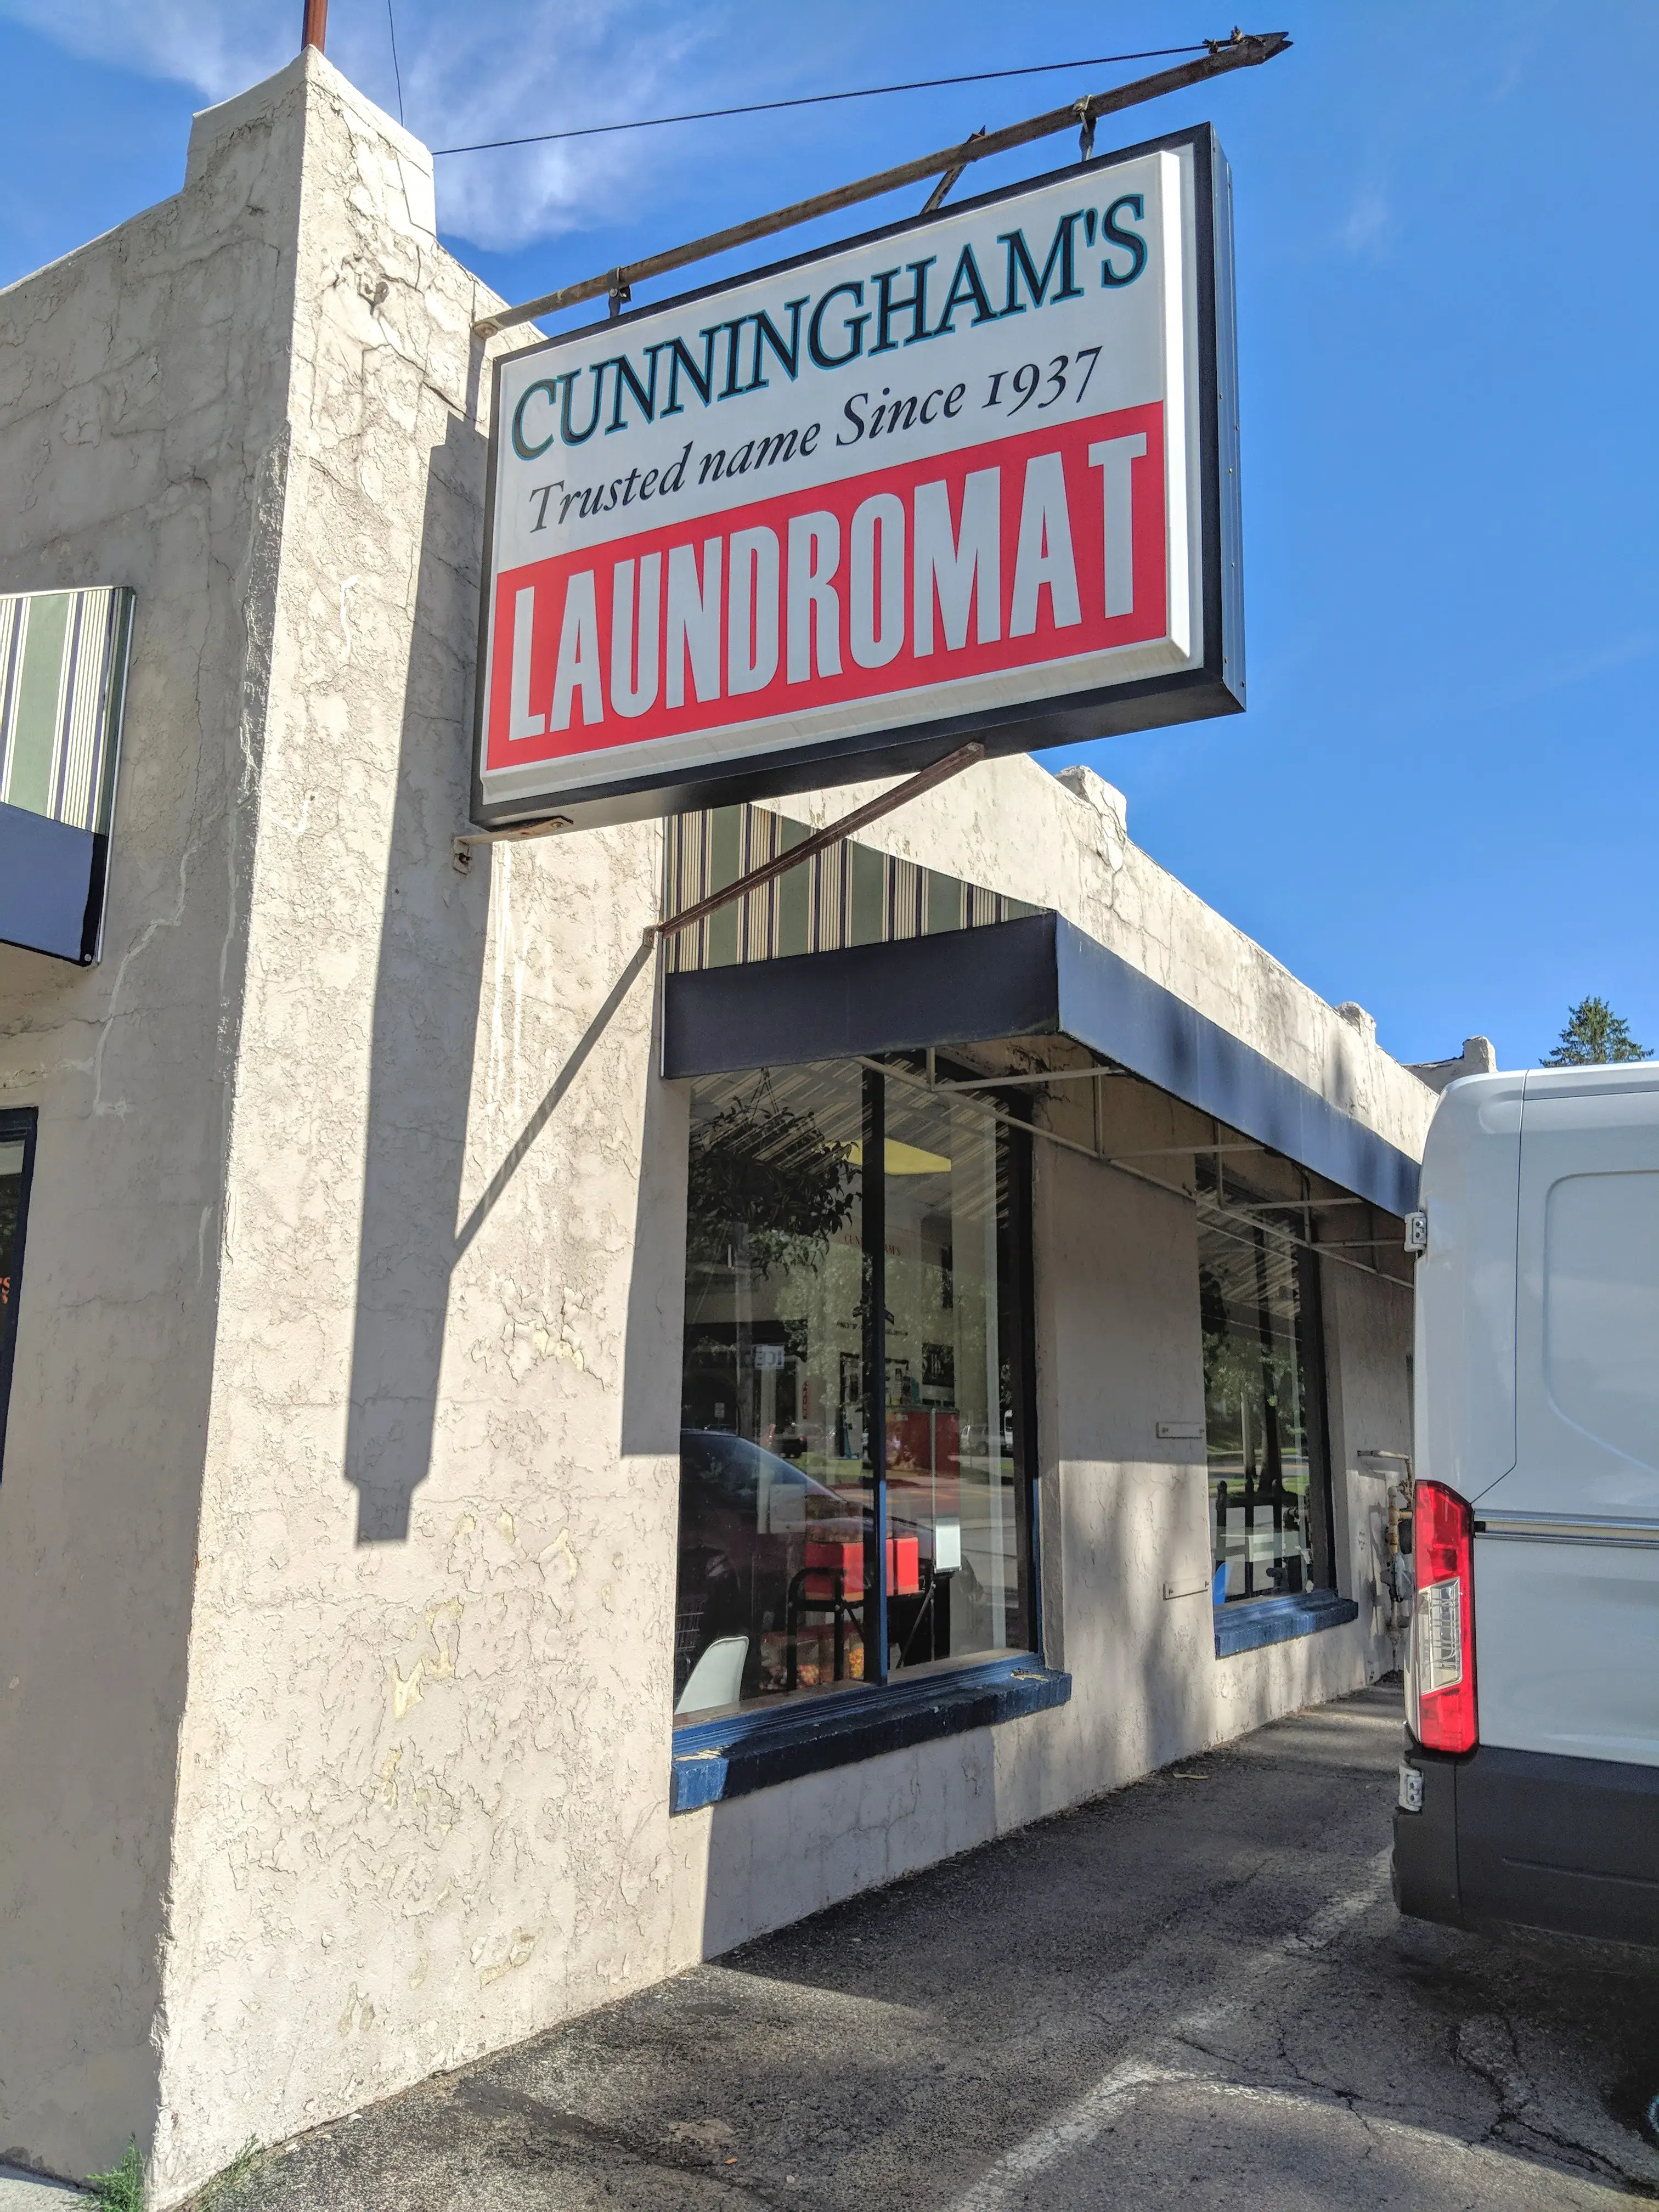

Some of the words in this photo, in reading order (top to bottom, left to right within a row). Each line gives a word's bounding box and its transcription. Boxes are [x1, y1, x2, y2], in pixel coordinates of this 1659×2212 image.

[512, 193, 1148, 461] CUNNINGHAM'S
[529, 441, 694, 533] Trusted
[698, 421, 821, 486] name
[836, 383, 966, 447] Since
[981, 346, 1103, 417] 1937
[509, 432, 1148, 741] LAUNDROMAT
